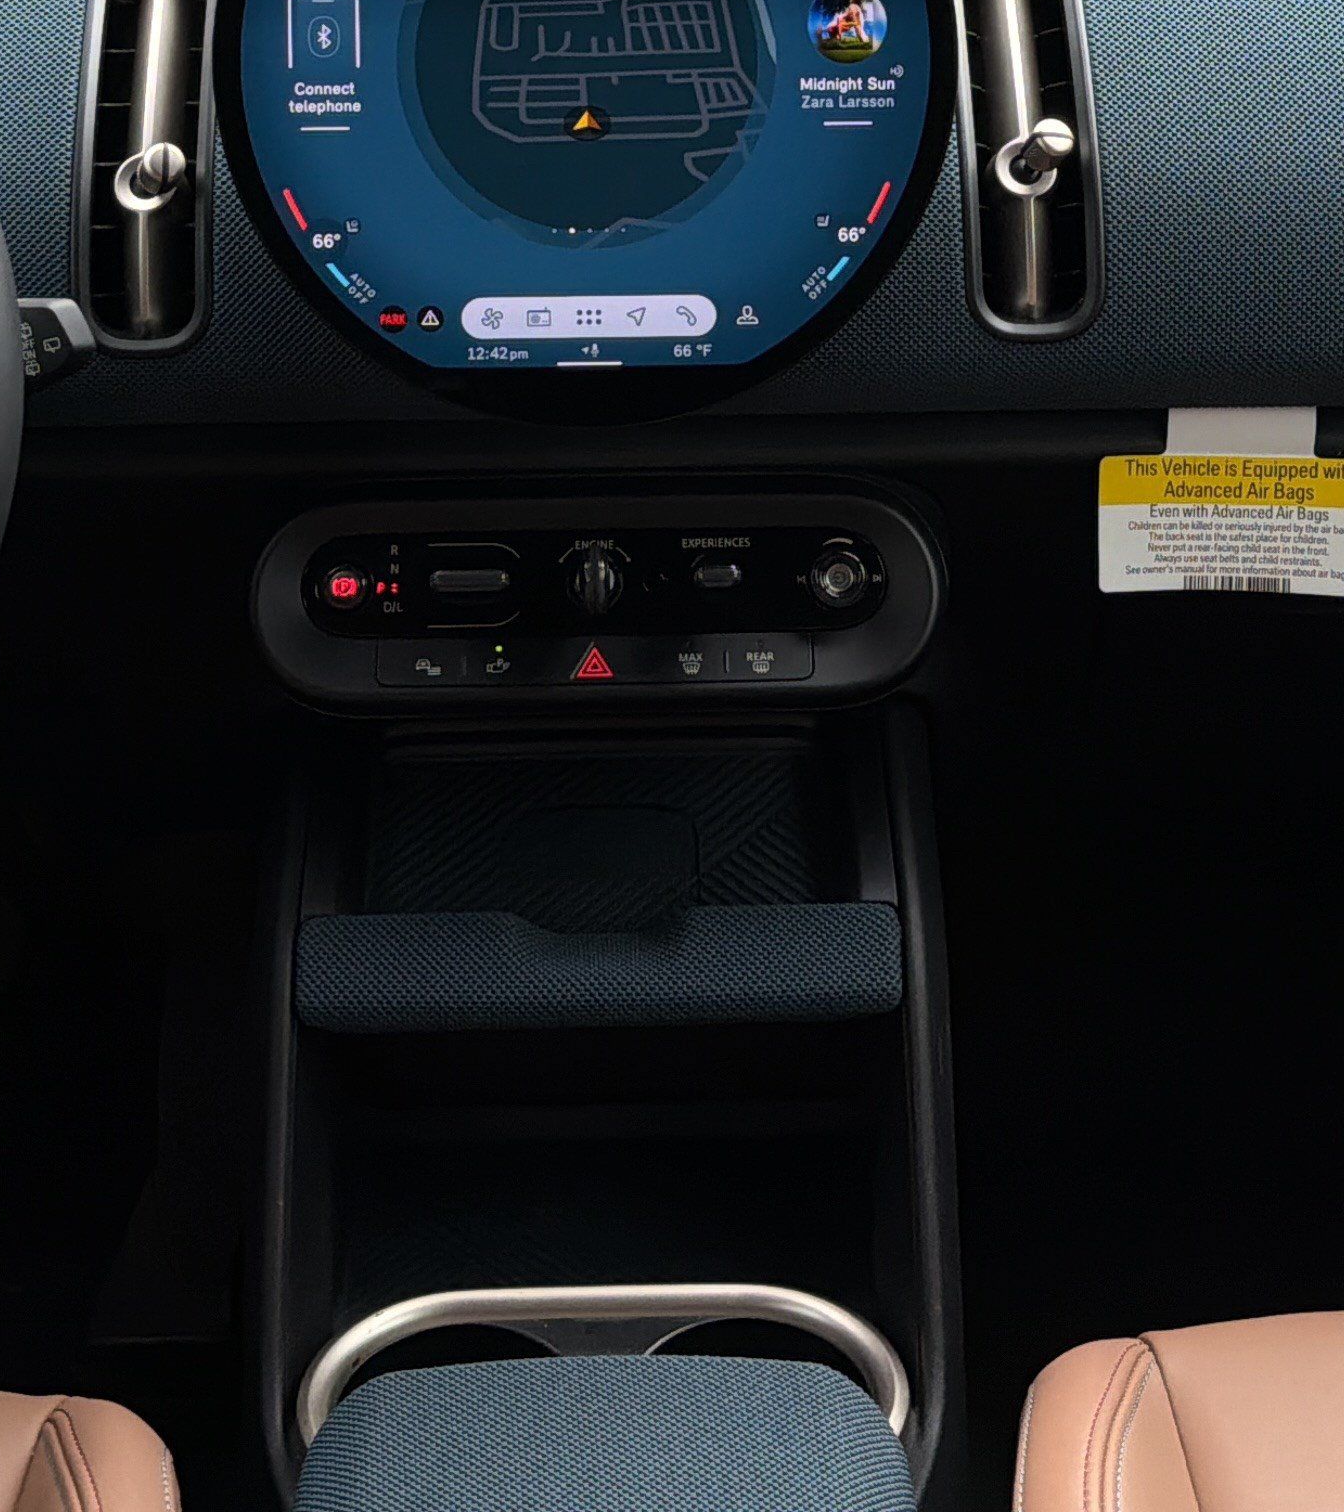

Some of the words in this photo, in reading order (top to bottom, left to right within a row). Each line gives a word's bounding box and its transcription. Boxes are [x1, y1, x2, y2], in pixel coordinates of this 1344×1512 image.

[294, 82, 355, 95] Connect
[800, 77, 863, 93] Midnight
[867, 77, 895, 91] Sun
[289, 100, 362, 115] telephone
[801, 95, 833, 109] Zara
[839, 95, 895, 108] Larsson
[313, 233, 341, 249] 66°
[838, 227, 866, 242] 66°
[349, 272, 377, 299] AUTO
[801, 266, 826, 293] AUTO
[348, 285, 369, 305] OFF
[809, 280, 828, 300] OFF
[379, 313, 406, 326] PARK
[673, 344, 692, 358] 66
[696, 343, 712, 358] °F
[1125, 459, 1158, 476] This
[1161, 459, 1220, 476] Vehicle
[1224, 459, 1237, 477] is
[1242, 460, 1319, 481] Equipped
[1164, 481, 1243, 498] Advanced
[1247, 482, 1270, 499] Air
[1274, 483, 1315, 504] Bags
[1149, 504, 1180, 518] Even
[1182, 505, 1208, 518] with
[1211, 504, 1273, 519] Advanced
[1276, 506, 1294, 519] Air
[1297, 506, 1329, 523] Bags
[1128, 521, 1161, 530] Children
[1163, 522, 1177, 530] can
[1179, 521, 1189, 530] be
[1192, 521, 1212, 531] killed
[1225, 522, 1261, 533] seriously
[1263, 523, 1292, 533] injured
[1293, 524, 1303, 535] by
[1305, 525, 1318, 533] the
[1321, 526, 1331, 534] air
[681, 537, 751, 549] EXPERIENCES
[1149, 532, 1163, 541] The
[1165, 532, 1184, 541] back
[1186, 533, 1203, 541] seat
[1206, 533, 1212, 541] is
[1214, 533, 1227, 541] the
[1229, 533, 1254, 542] safest
[1255, 534, 1278, 546] place
[1280, 534, 1291, 543] for
[1293, 535, 1329, 544] children.
[390, 544, 400, 556] R
[1148, 543, 1171, 552] Never
[1173, 544, 1186, 555] put
[1194, 543, 1239, 554] rear-facing
[1241, 544, 1261, 553] child
[1282, 545, 1290, 553] in
[1292, 546, 1305, 554] the
[1307, 546, 1329, 556] front.
[1154, 554, 1182, 565] Always
[1200, 555, 1217, 563] seat
[1219, 555, 1239, 563] belts
[1241, 555, 1256, 564] and
[1259, 555, 1278, 564] child
[1280, 557, 1322, 566] restraints.
[390, 563, 400, 574] N
[1125, 566, 1141, 575] See
[1207, 565, 1217, 573] for
[1242, 566, 1290, 576] information
[1292, 568, 1317, 577] about
[1318, 569, 1328, 577] air
[383, 601, 404, 613] D/L
[678, 652, 703, 662] MAX
[746, 651, 775, 661] REAR
